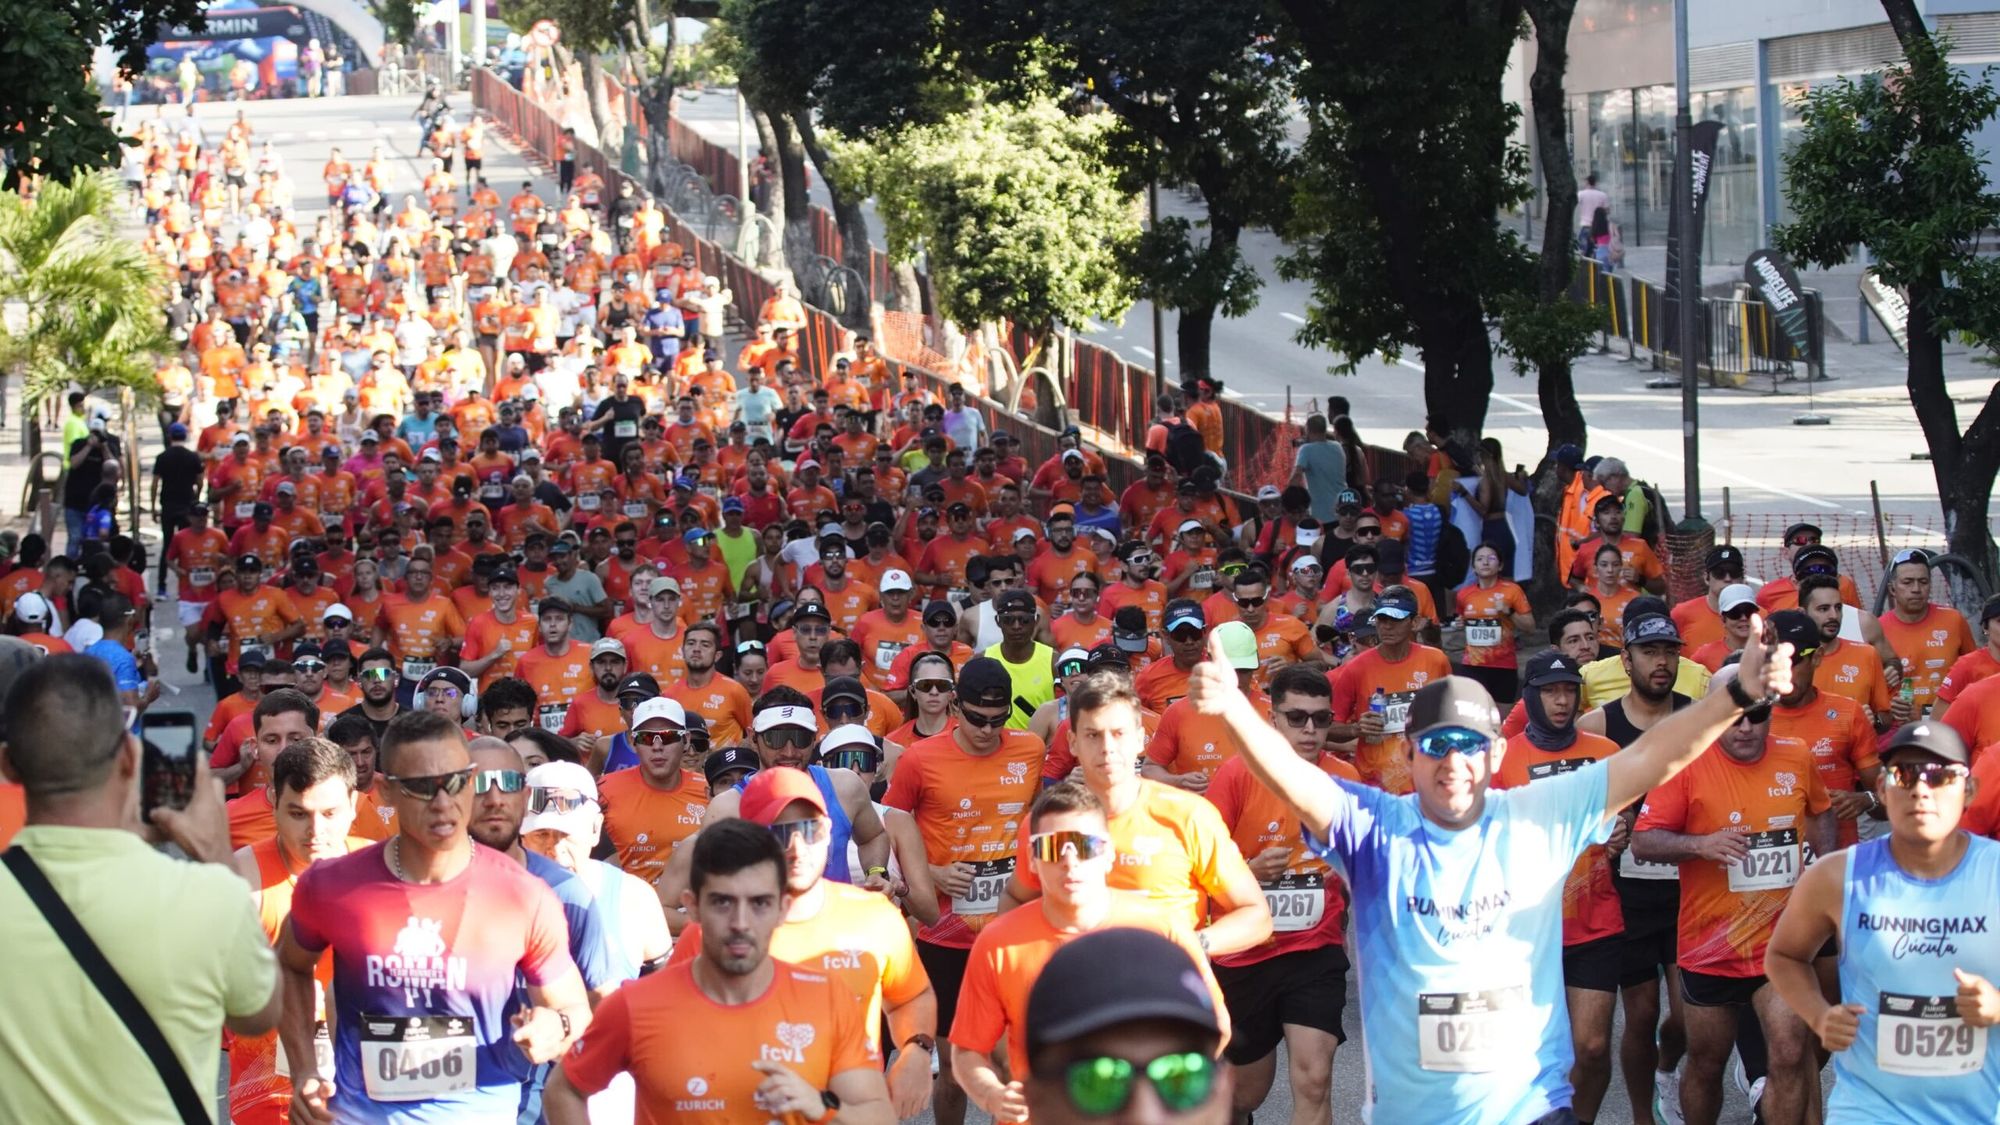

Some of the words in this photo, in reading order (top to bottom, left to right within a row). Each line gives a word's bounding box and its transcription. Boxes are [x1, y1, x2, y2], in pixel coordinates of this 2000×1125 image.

[172, 18, 258, 37] GRMIN
[1753, 256, 1798, 308] MORELIFE
[952, 811, 981, 819] ZURICH
[1258, 834, 1286, 842] ZURICH
[1742, 850, 1792, 878] 0221
[1266, 893, 1315, 917] 0267
[1858, 913, 1987, 934] RUNNINGMAX
[1893, 934, 1958, 960] Cúcuta
[366, 953, 468, 991] ROMAN
[1894, 1023, 1974, 1057] 0529
[760, 1044, 794, 1062] fcv
[676, 1099, 725, 1111] ZURICH
